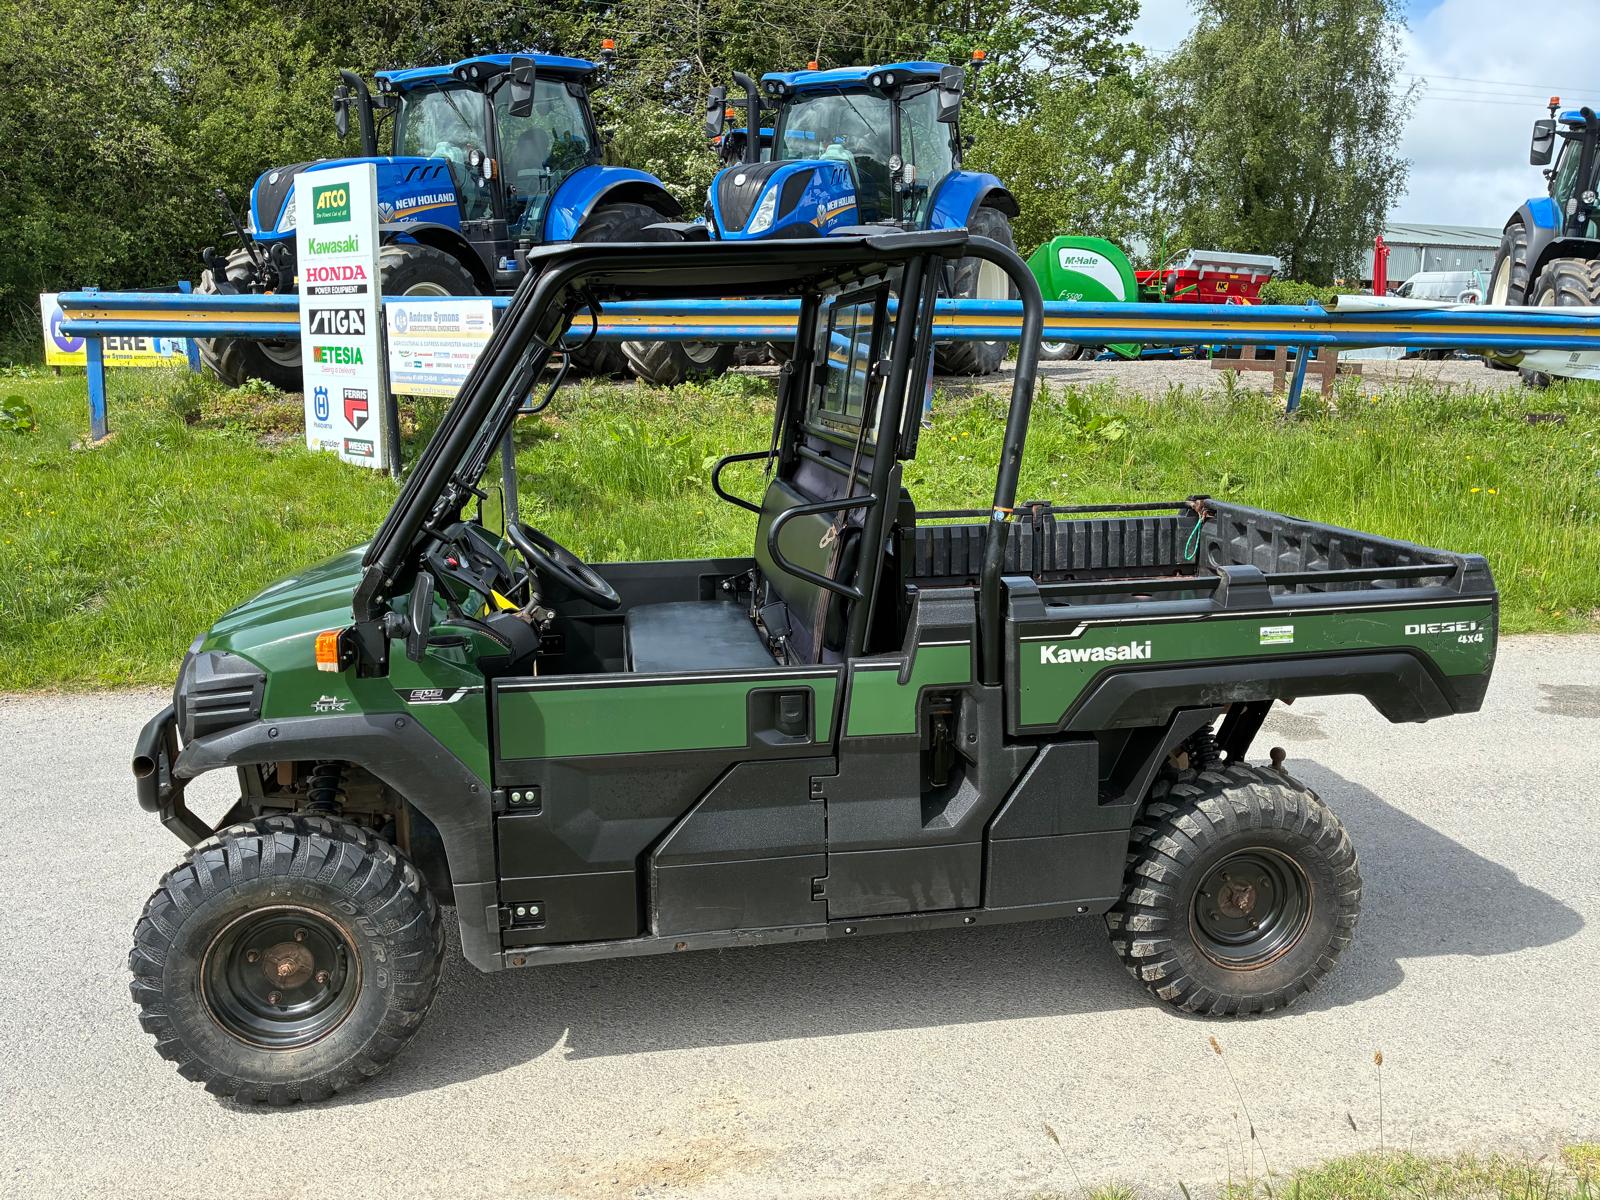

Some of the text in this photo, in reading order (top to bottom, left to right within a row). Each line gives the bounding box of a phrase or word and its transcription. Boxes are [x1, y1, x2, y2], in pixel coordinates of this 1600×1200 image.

[317, 189, 347, 210] ATCO
[395, 193, 455, 209] NEW HOLLAND
[827, 200, 838, 211] NEW
[308, 234, 359, 255] Kawasaki
[306, 265, 367, 282] HONDA
[315, 285, 358, 295] POWER EQUIPMENT
[310, 310, 364, 334] STIGA
[409, 312, 432, 323] Andrew
[434, 312, 459, 324] Symons
[344, 390, 367, 400] FERRIS
[1404, 620, 1484, 635] DIESEL
[1457, 633, 1484, 644] 4x4
[1040, 640, 1152, 664] Kawasaki
